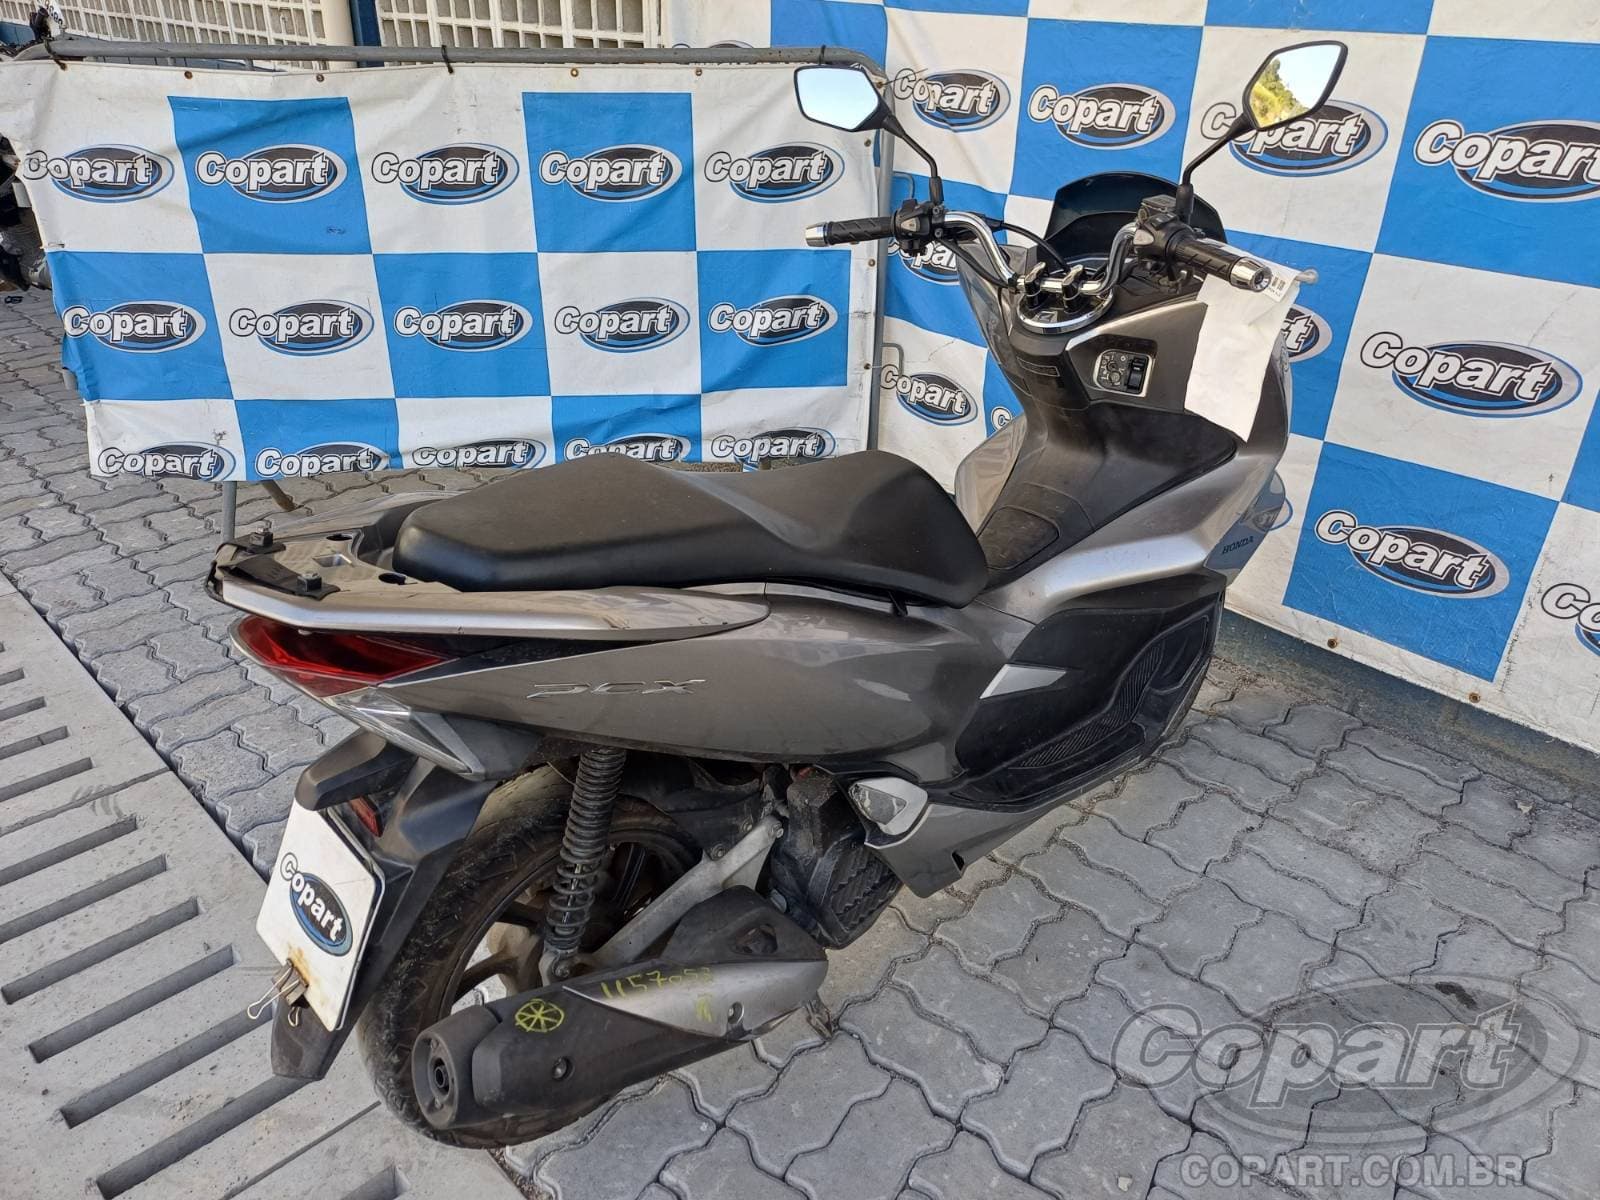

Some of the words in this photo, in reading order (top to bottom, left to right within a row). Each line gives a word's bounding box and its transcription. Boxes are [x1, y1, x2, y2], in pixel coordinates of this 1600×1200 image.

[893, 68, 996, 116] Copart
[1029, 85, 1159, 134] Copart
[1200, 101, 1363, 155] Cpart
[23, 150, 152, 190] Copart
[196, 151, 329, 193] Copart
[372, 151, 501, 193] Copart
[540, 150, 667, 193] Copart
[704, 150, 829, 192] Copart
[63, 305, 187, 343] Copart
[229, 307, 356, 345] Copart
[395, 304, 517, 343] Copart
[555, 303, 670, 342] Copart
[708, 302, 820, 340] Copart
[1360, 331, 1554, 402] Copart
[880, 363, 967, 415] Copart
[98, 446, 216, 478] Copart
[255, 447, 373, 477] Copart
[412, 446, 528, 471] Copart
[711, 433, 819, 462] Copart
[1222, 535, 1254, 555] HONDA
[1315, 510, 1489, 590] Copart
[280, 852, 343, 942] Copart
